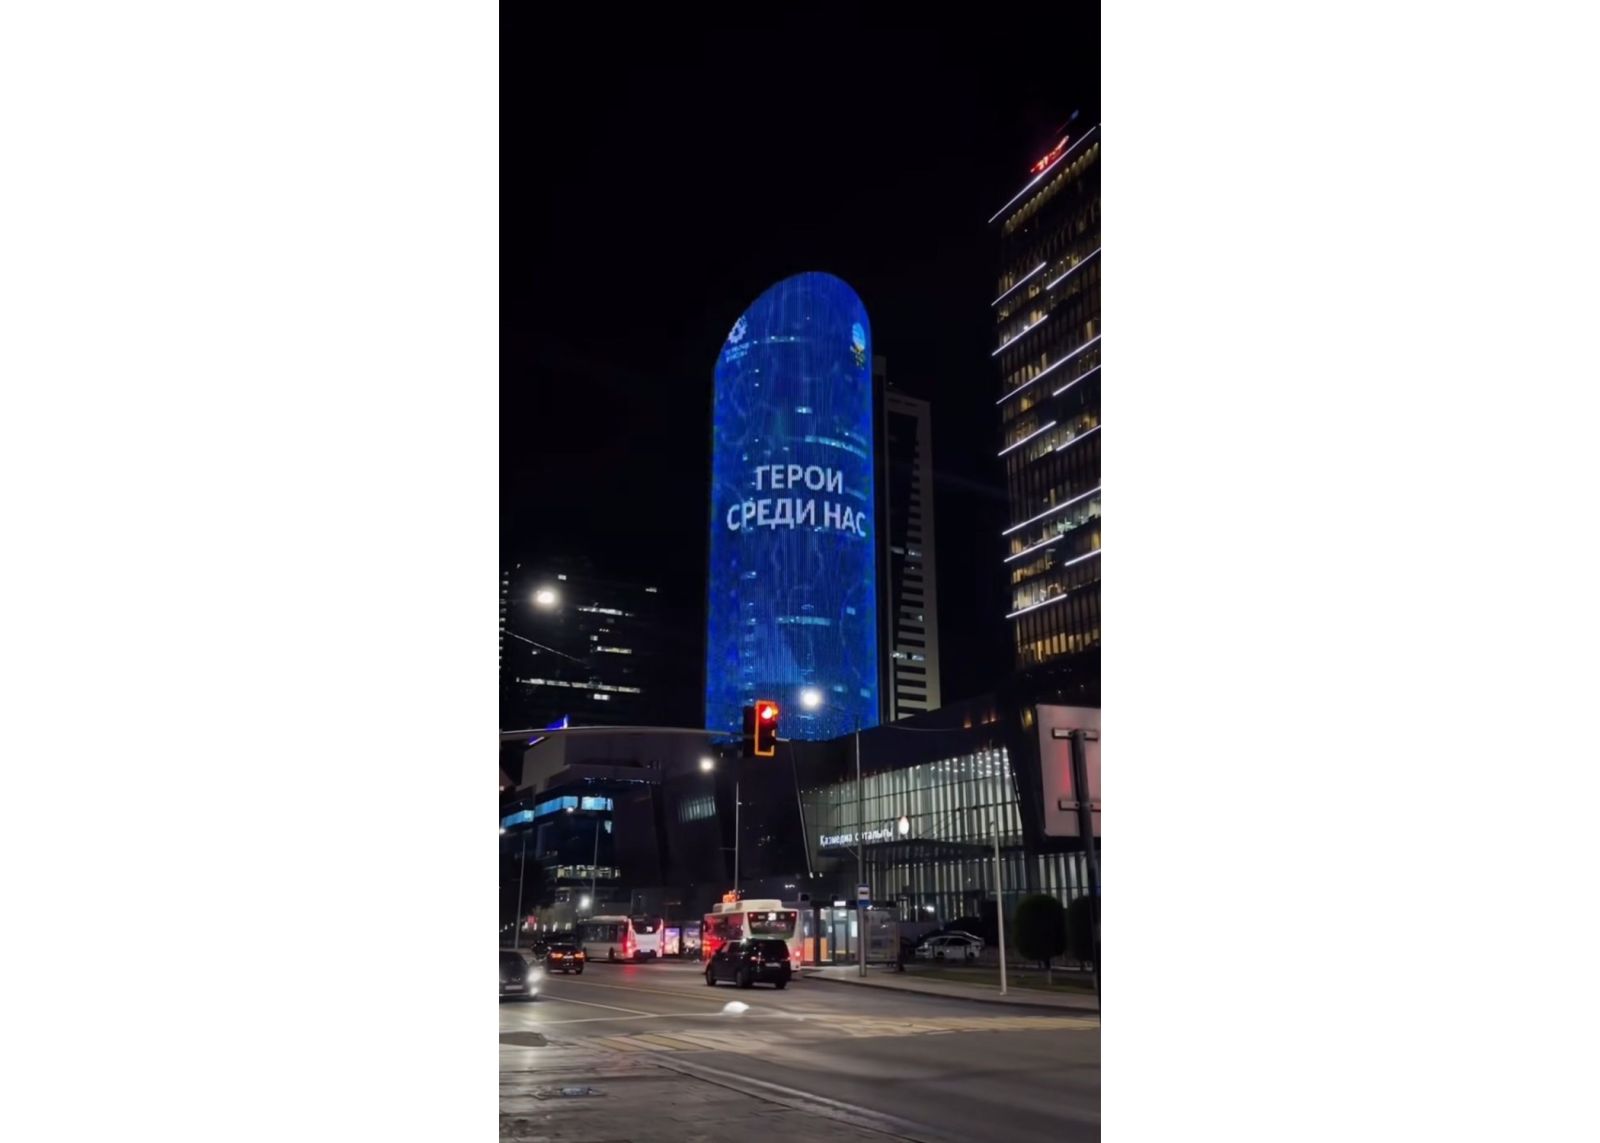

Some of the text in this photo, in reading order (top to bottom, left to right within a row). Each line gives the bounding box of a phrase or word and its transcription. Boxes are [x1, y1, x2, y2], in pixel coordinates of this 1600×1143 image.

[755, 464, 843, 495] ГЕРОИ
[726, 498, 867, 537] СРЕДИ НАС
